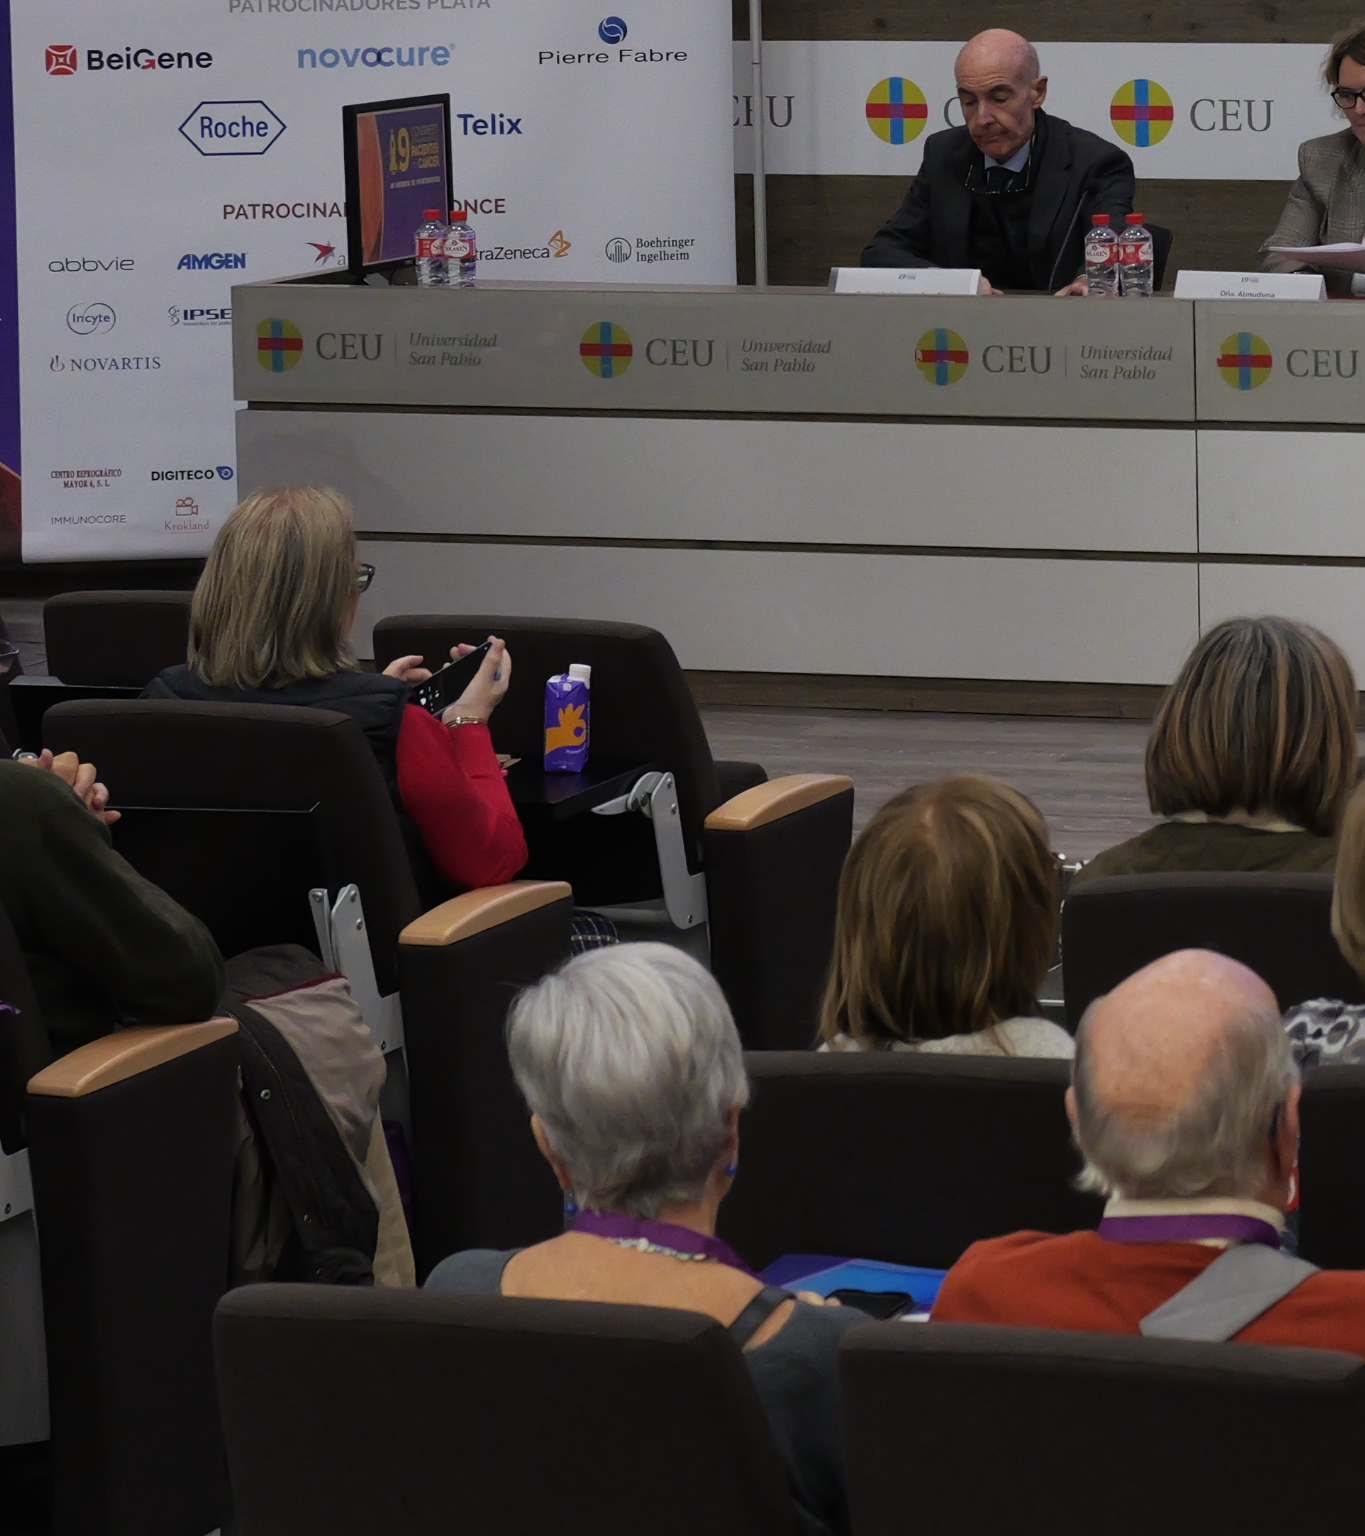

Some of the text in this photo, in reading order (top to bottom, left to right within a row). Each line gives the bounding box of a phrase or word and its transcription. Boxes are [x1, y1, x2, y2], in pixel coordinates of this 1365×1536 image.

[86, 46, 213, 71] BeiGene
[538, 48, 688, 65] Pierre Fabre
[1189, 98, 1274, 133] CEU
[199, 116, 269, 139] Roche
[456, 112, 523, 136] Telix
[222, 198, 506, 221] PATROCINA ONCE
[636, 237, 695, 249] Boehringer
[177, 252, 246, 270] AMGEN
[474, 246, 550, 261] traZeneca
[636, 250, 690, 263] Ingelheim
[47, 256, 135, 273] abbvie
[72, 312, 111, 326] Incyte
[183, 308, 232, 321] IPSE
[315, 332, 383, 361] CEU
[409, 332, 498, 348] Universidad
[742, 339, 832, 354] Universidad
[442, 352, 483, 368] Pablo
[645, 337, 714, 367] CEU
[981, 344, 1052, 375] CEU
[1080, 345, 1173, 361] Universidad
[70, 356, 162, 372] NOVARTIS
[773, 358, 816, 372] Pablo
[1285, 348, 1359, 379] CEU
[1112, 365, 1156, 380] Pablo
[50, 470, 75, 478] CENTRO
[151, 469, 214, 481] DIGITECO
[50, 514, 127, 525] IMMUNOCORE
[164, 519, 210, 531] Krokland
